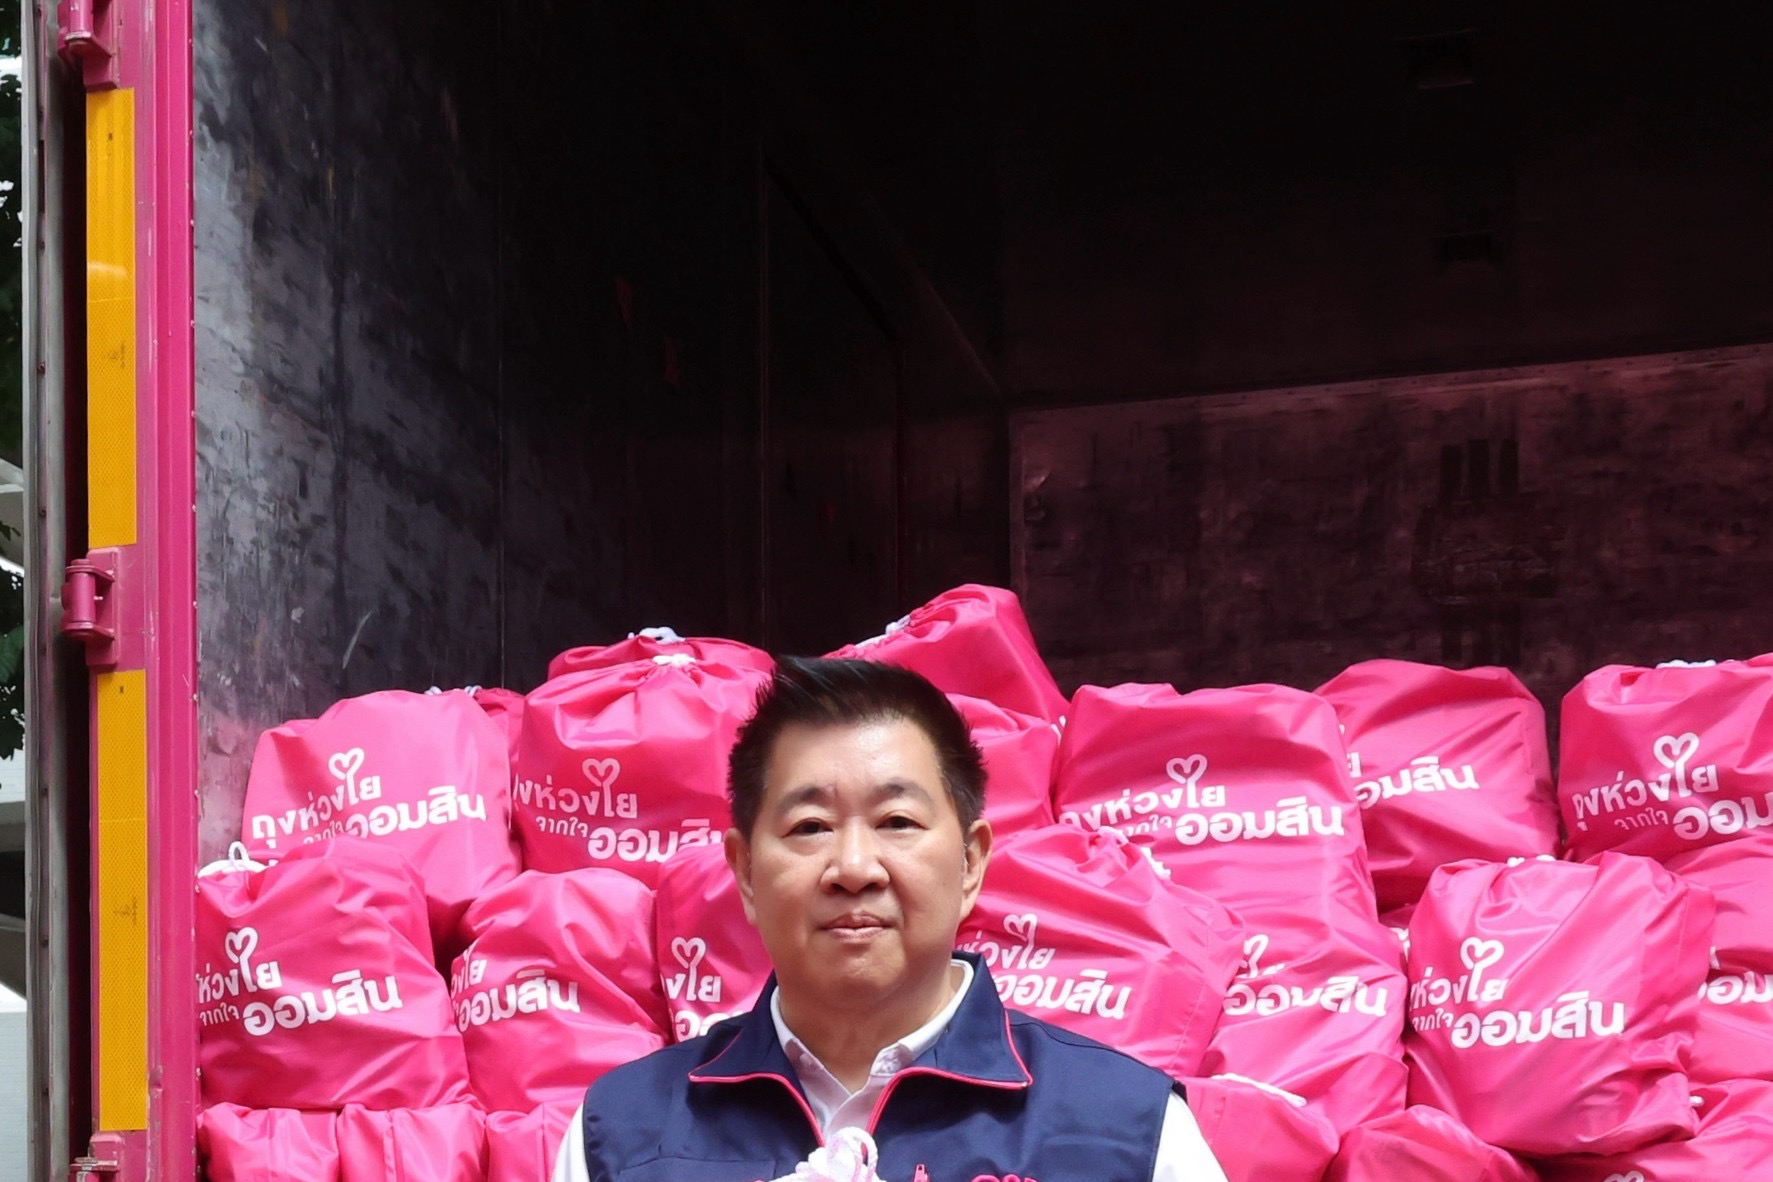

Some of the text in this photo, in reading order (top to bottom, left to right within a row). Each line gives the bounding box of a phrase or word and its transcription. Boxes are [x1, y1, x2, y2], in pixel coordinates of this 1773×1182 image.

[252, 748, 381, 848] ถุงห่วงใย
[536, 816, 588, 839] จากใจ
[1174, 796, 1345, 846] ออมสิน
[243, 969, 404, 1036] ออมสิน
[459, 968, 581, 1033] ออมสิน
[1410, 936, 1509, 1011] ห่วงใย
[1451, 990, 1625, 1049] ออมสิน
